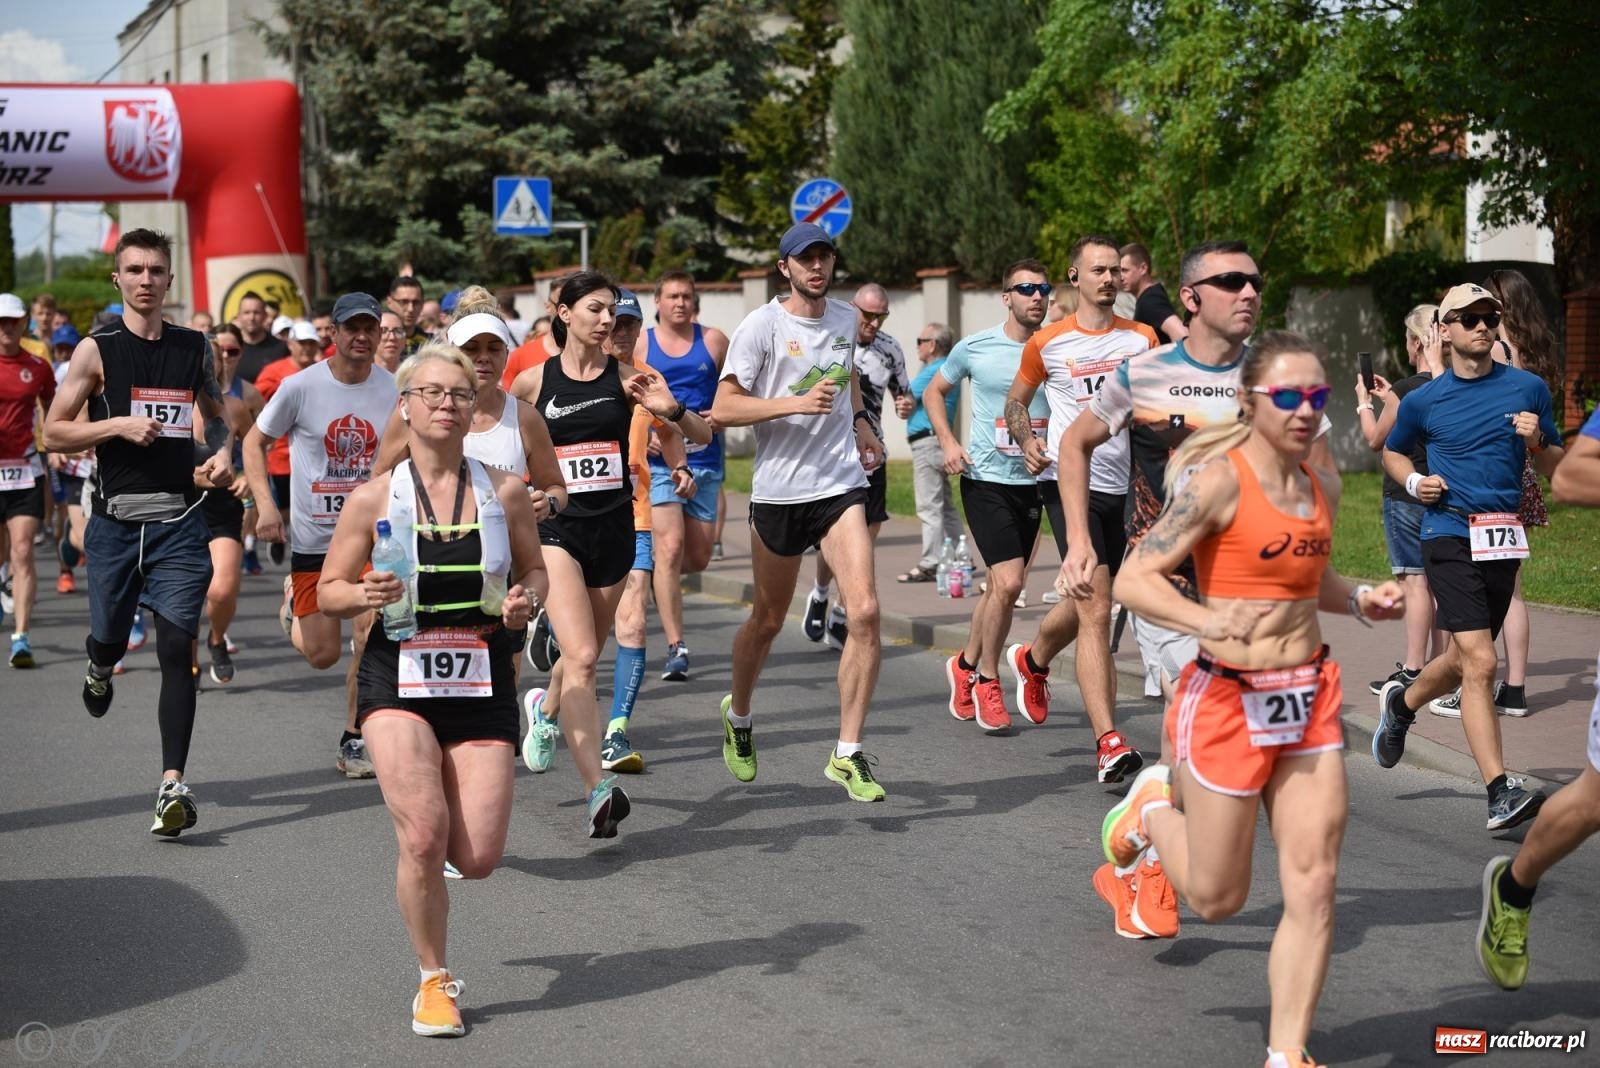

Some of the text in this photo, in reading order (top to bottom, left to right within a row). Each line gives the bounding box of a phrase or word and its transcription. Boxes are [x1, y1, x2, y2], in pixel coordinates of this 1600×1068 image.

[145, 404, 181, 424] 157
[1, 468, 22, 480] 127
[568, 457, 610, 480] 182
[1485, 527, 1517, 547] 173
[420, 652, 472, 679] 197
[621, 658, 645, 712] Kalenji
